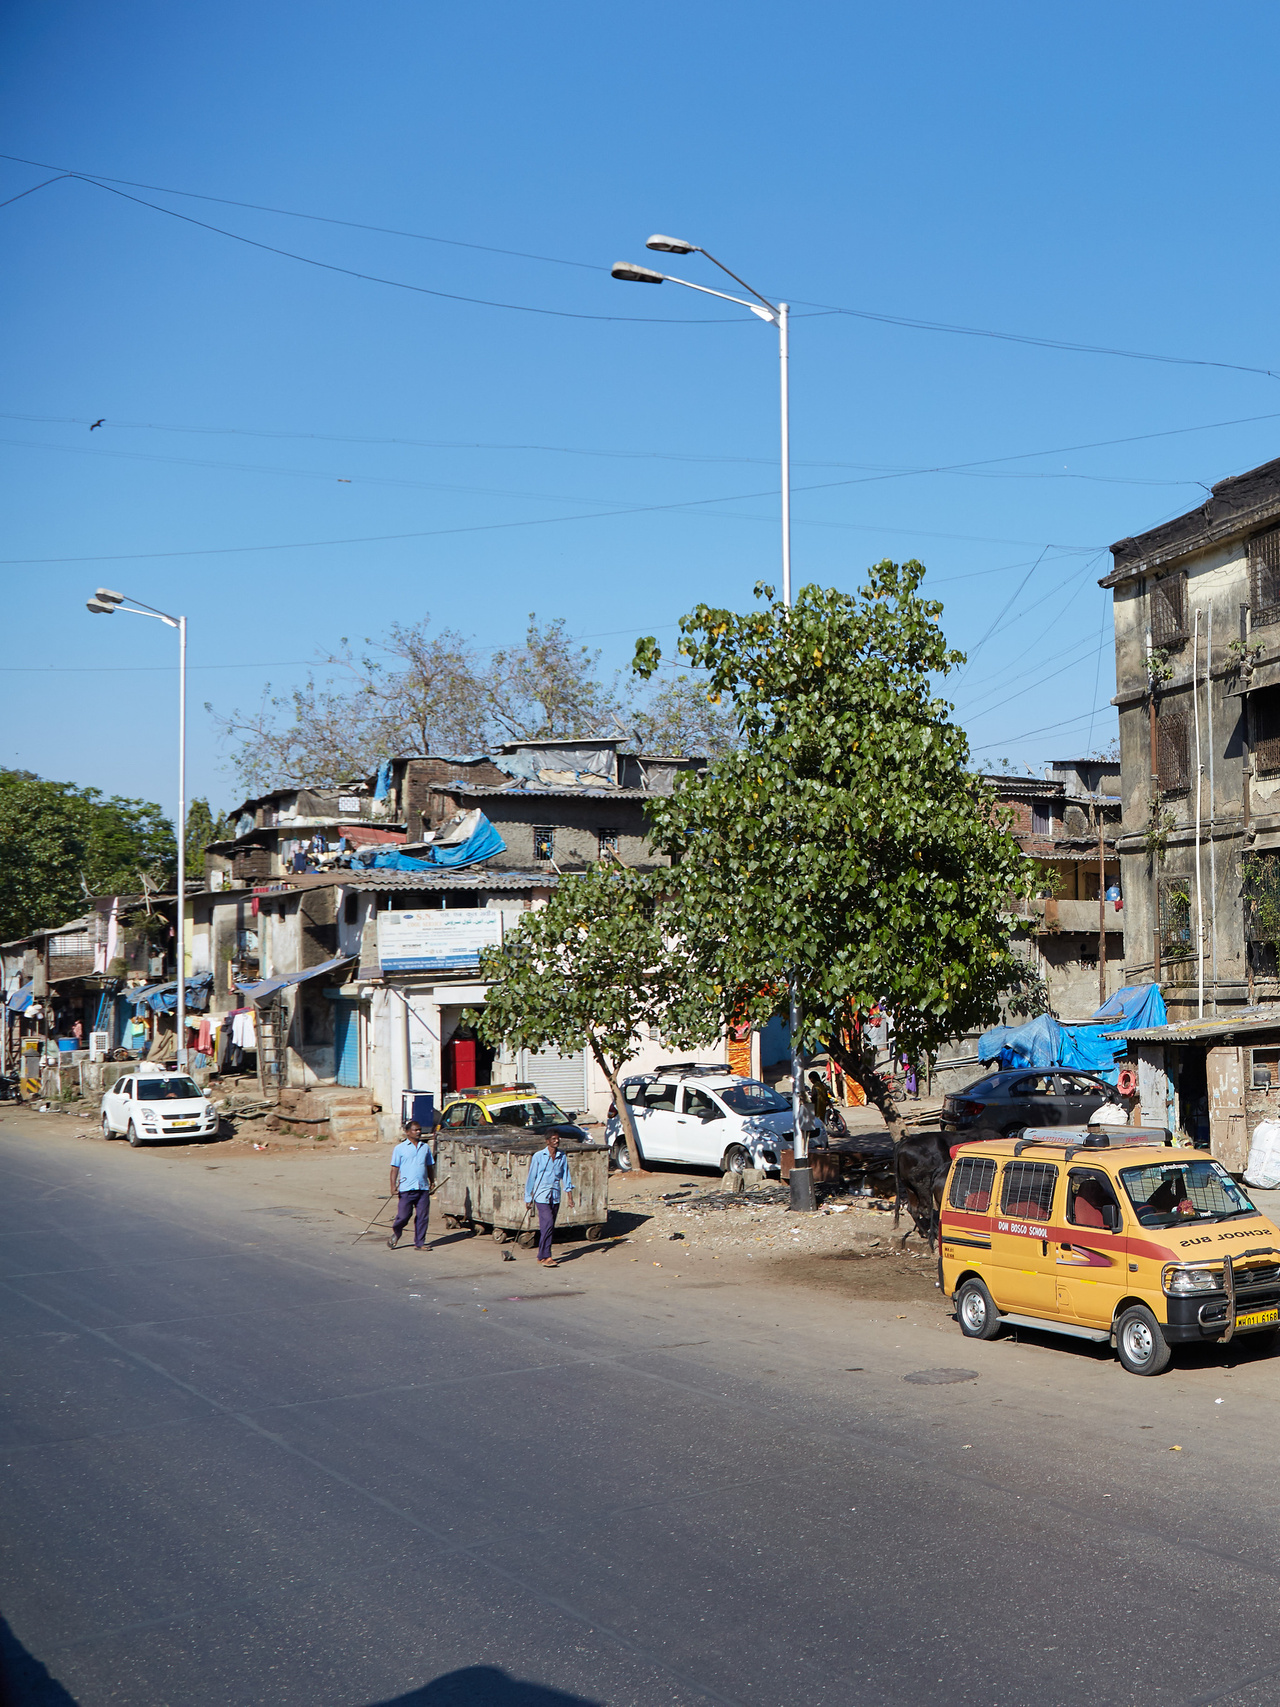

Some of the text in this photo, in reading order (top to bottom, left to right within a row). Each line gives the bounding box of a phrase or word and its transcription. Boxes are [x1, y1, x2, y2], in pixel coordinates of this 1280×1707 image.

[998, 1221, 1048, 1238] DON BOSCO SCHOOL
